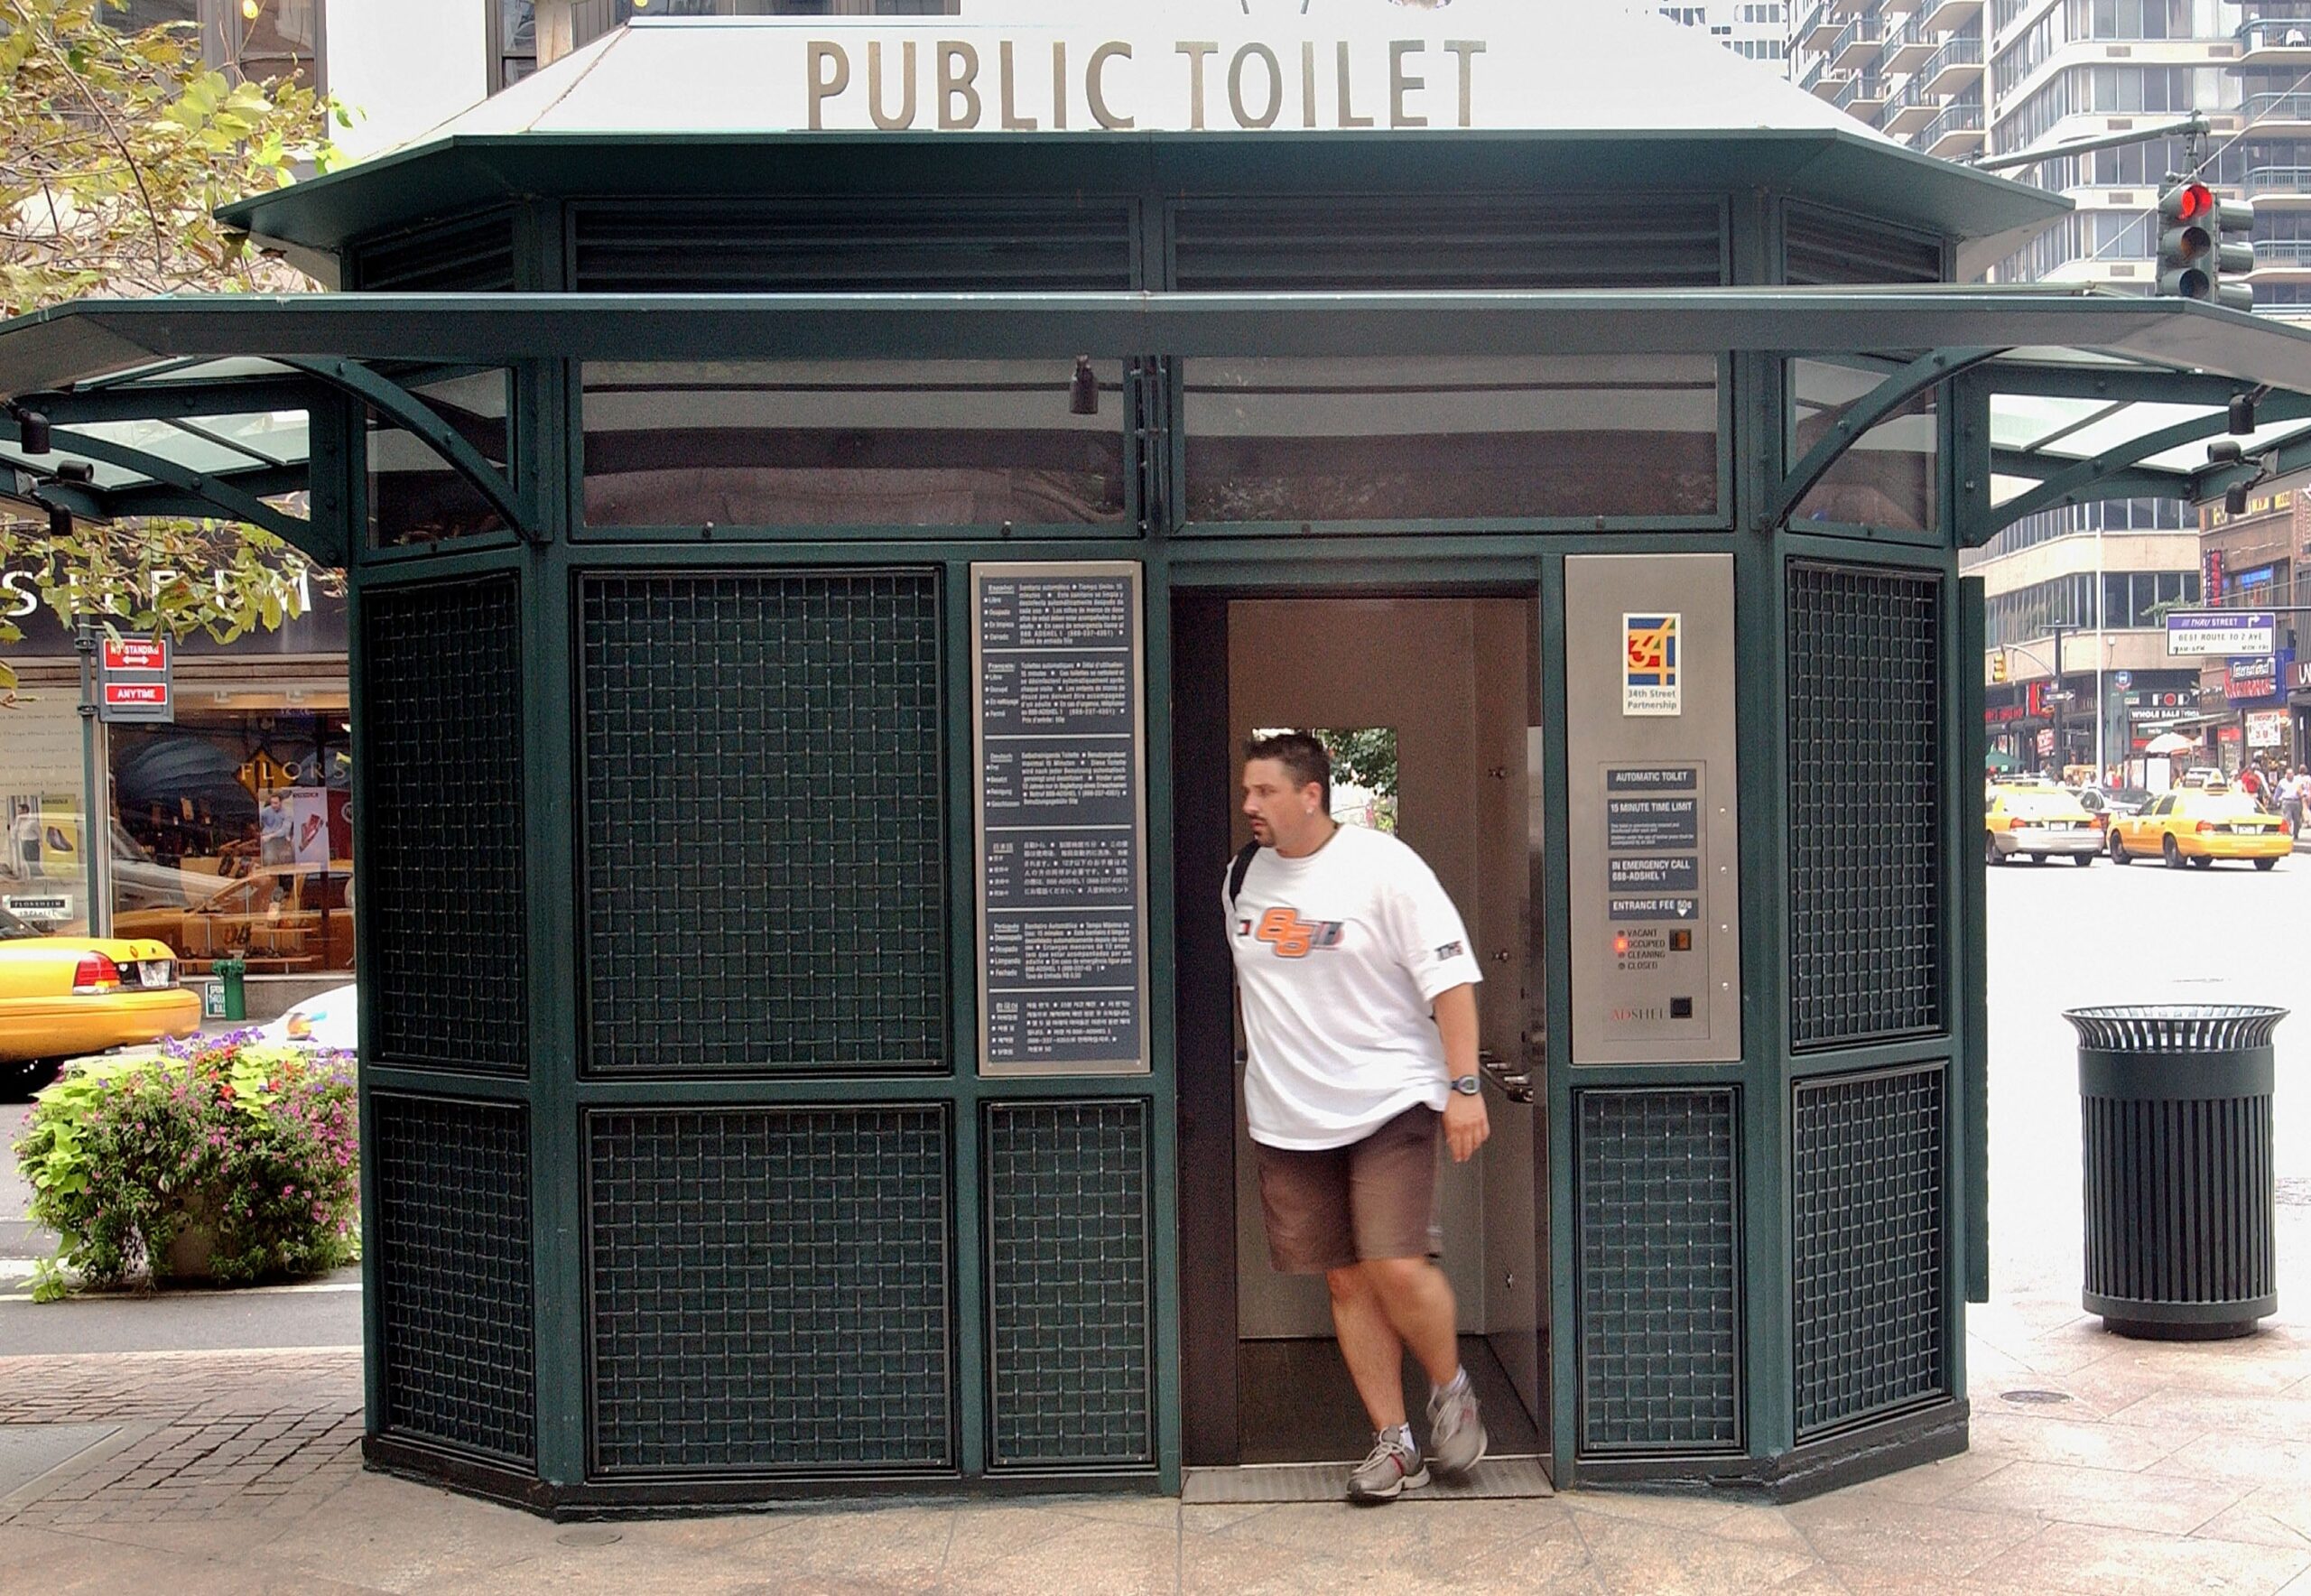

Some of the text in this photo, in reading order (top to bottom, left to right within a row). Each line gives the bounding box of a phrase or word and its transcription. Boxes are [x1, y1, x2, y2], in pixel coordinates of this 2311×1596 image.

[807, 40, 1487, 131] PUBLIC TOILET
[2211, 617, 2238, 626] STREET
[2178, 634, 2197, 642] BEST
[2249, 633, 2262, 641] AVE
[117, 689, 155, 699] ANYTIME
[1629, 689, 1676, 698] 34th Street
[1628, 701, 1677, 710] Partnership
[2131, 710, 2160, 719] WHOLE
[2161, 710, 2180, 719] SALE
[239, 761, 347, 781] FLORS
[1616, 771, 1687, 783] AUTOMATIC TOILET
[1620, 802, 1650, 812] MINUTE
[1651, 802, 1671, 812] TIME
[1671, 801, 1693, 812] LIMIT
[1611, 859, 1691, 870] IN EMERGENCY CALL
[1612, 901, 1657, 912] ENTRANCE
[1659, 900, 1675, 910] FEE
[1627, 929, 1657, 937] VACANT
[1628, 939, 1666, 949] OCCUPIED
[1628, 950, 1666, 959] CLEANING
[1628, 961, 1658, 970] CLOSED
